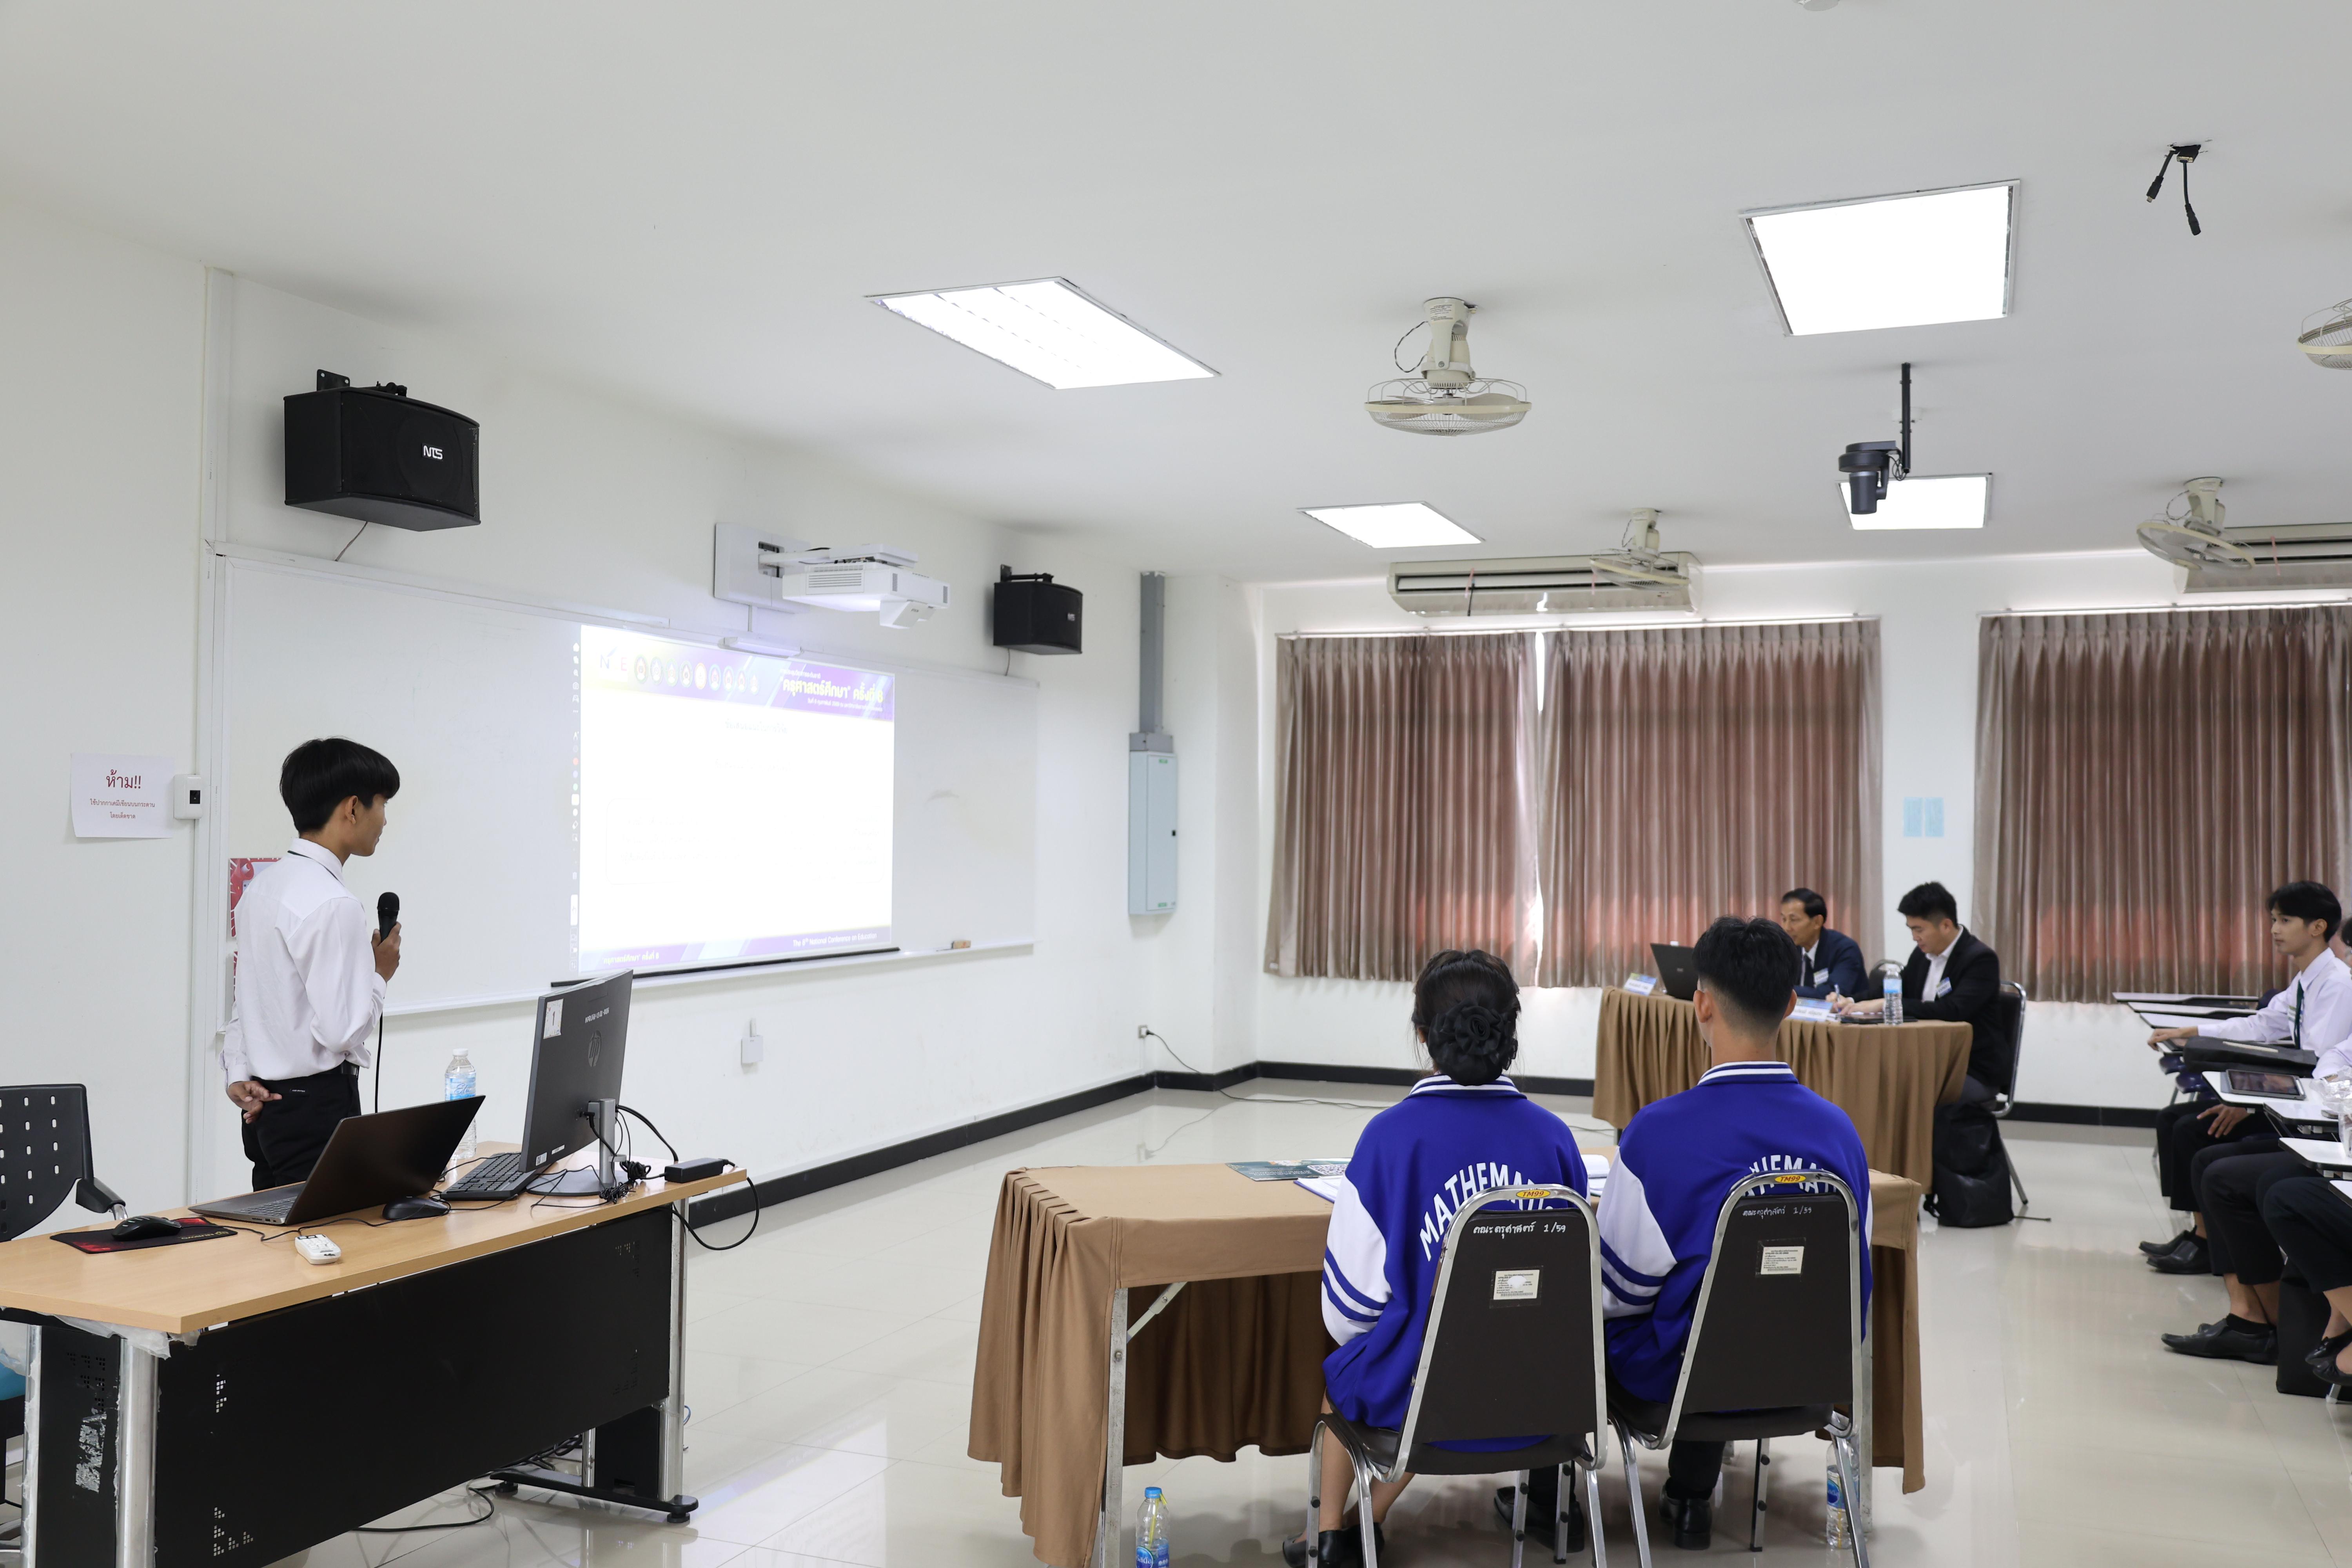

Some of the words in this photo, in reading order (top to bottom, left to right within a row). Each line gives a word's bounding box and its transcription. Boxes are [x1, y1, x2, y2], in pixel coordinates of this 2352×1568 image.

[423, 446, 443, 460] NTS
[853, 681, 875, 701] ครั้งที่
[106, 769, 141, 789] ห้าม!!
[90, 798, 155, 808] ใช้ปากกาเคมีเขียนบนกระดาน
[809, 937, 827, 945] National
